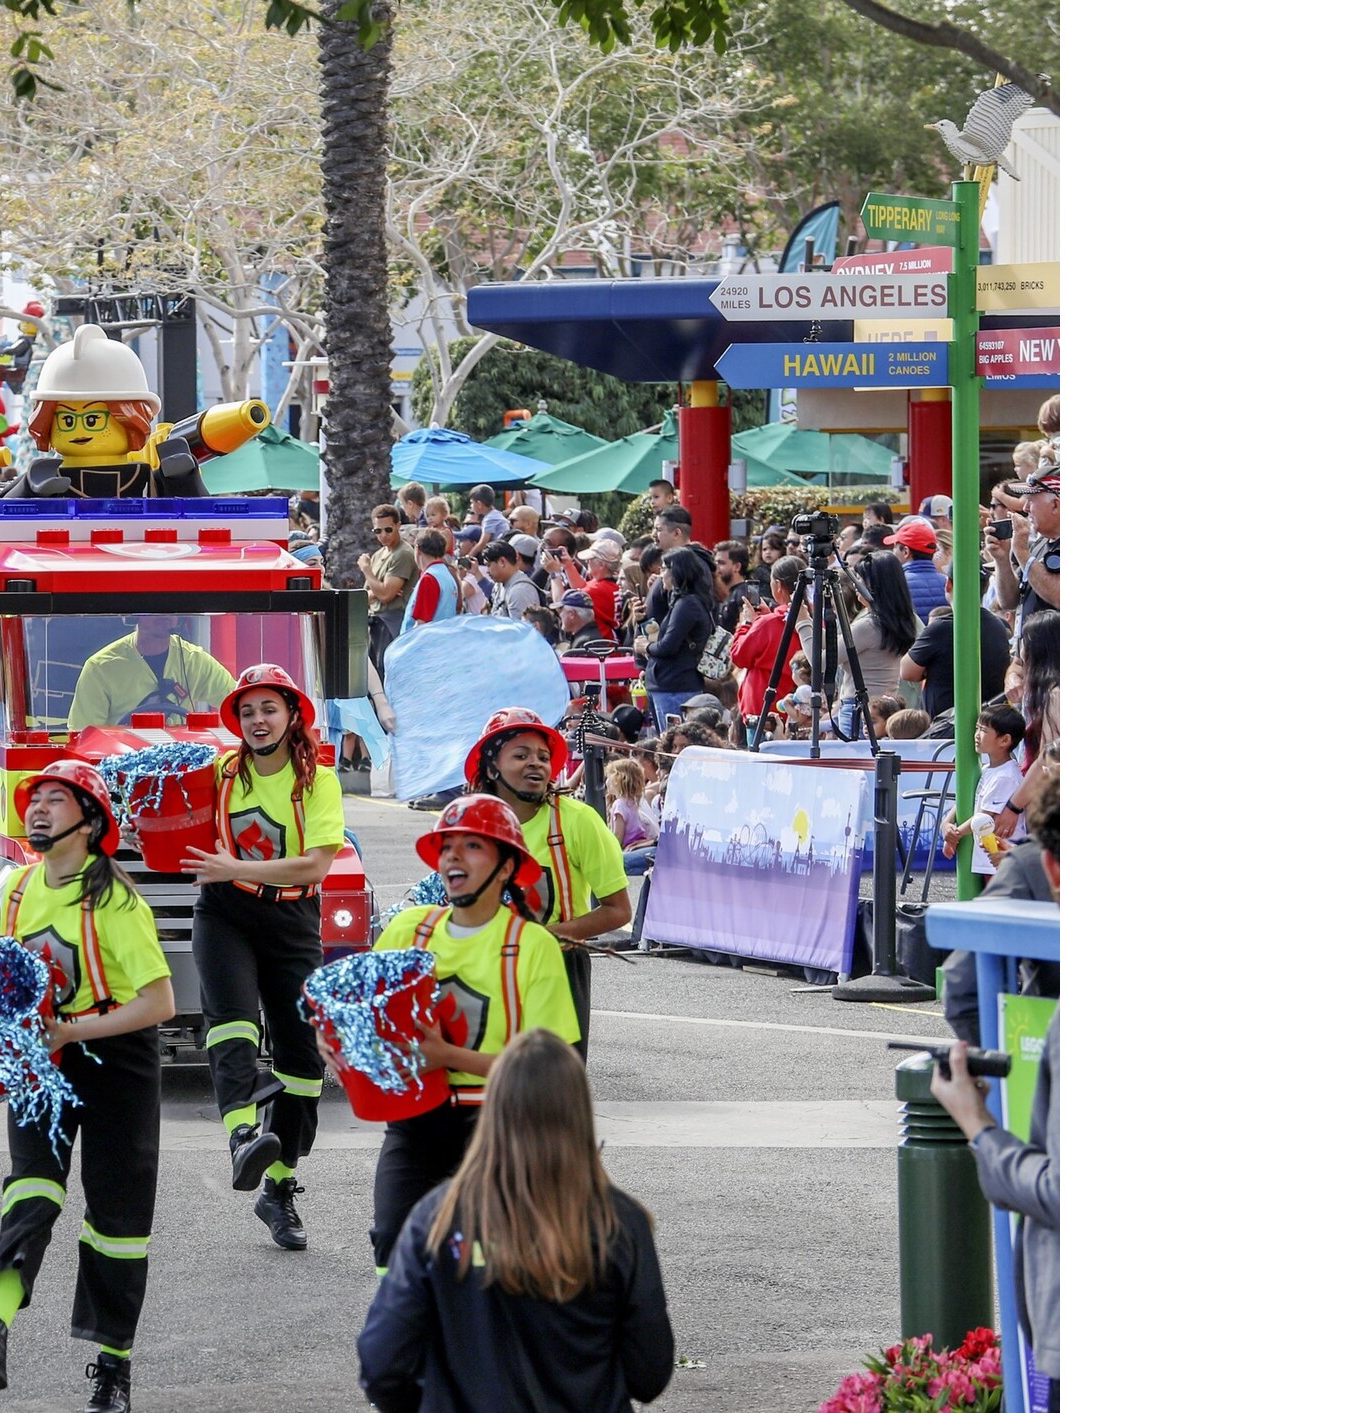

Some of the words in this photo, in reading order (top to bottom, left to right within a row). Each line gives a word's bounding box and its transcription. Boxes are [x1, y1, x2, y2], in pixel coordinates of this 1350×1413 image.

[867, 204, 932, 231] TIPPERARY
[899, 262, 908, 271] 7.5
[908, 259, 931, 270] MILLION
[1020, 281, 1044, 290] BRICKS
[720, 287, 748, 296] 24920
[758, 286, 812, 309] LOS
[820, 284, 947, 308] ANGELES
[720, 300, 751, 309] MILES
[1019, 339, 1055, 362] NEW
[888, 353, 895, 362] 2
[897, 352, 937, 362] MILLION
[979, 355, 989, 364] BIG
[990, 354, 1014, 364] APPLES
[783, 353, 875, 377] HAWAII
[888, 366, 930, 375] CANOES
